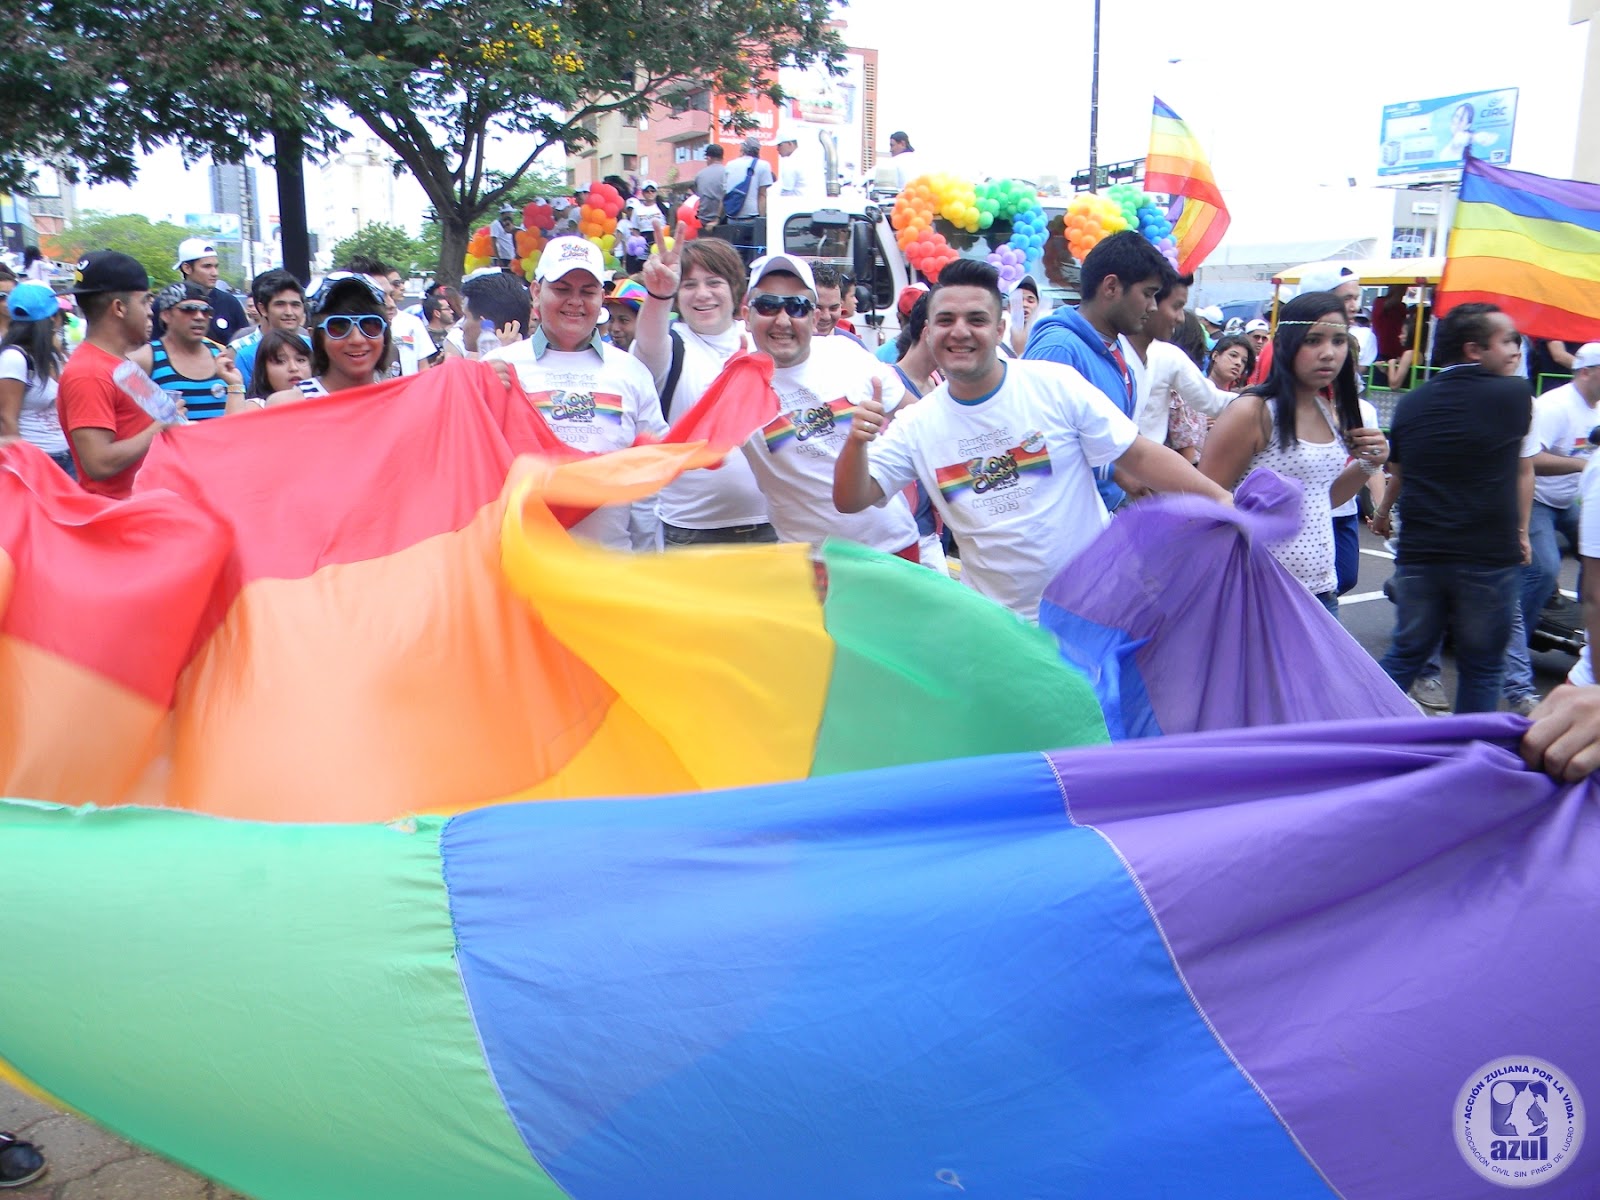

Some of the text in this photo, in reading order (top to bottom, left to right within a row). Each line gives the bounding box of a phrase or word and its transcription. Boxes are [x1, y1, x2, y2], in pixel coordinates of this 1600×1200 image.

[959, 433, 993, 448] Marcha
[959, 443, 993, 458] Orgullo
[972, 486, 1034, 508] Maracaibo
[989, 500, 1020, 516] 2013
